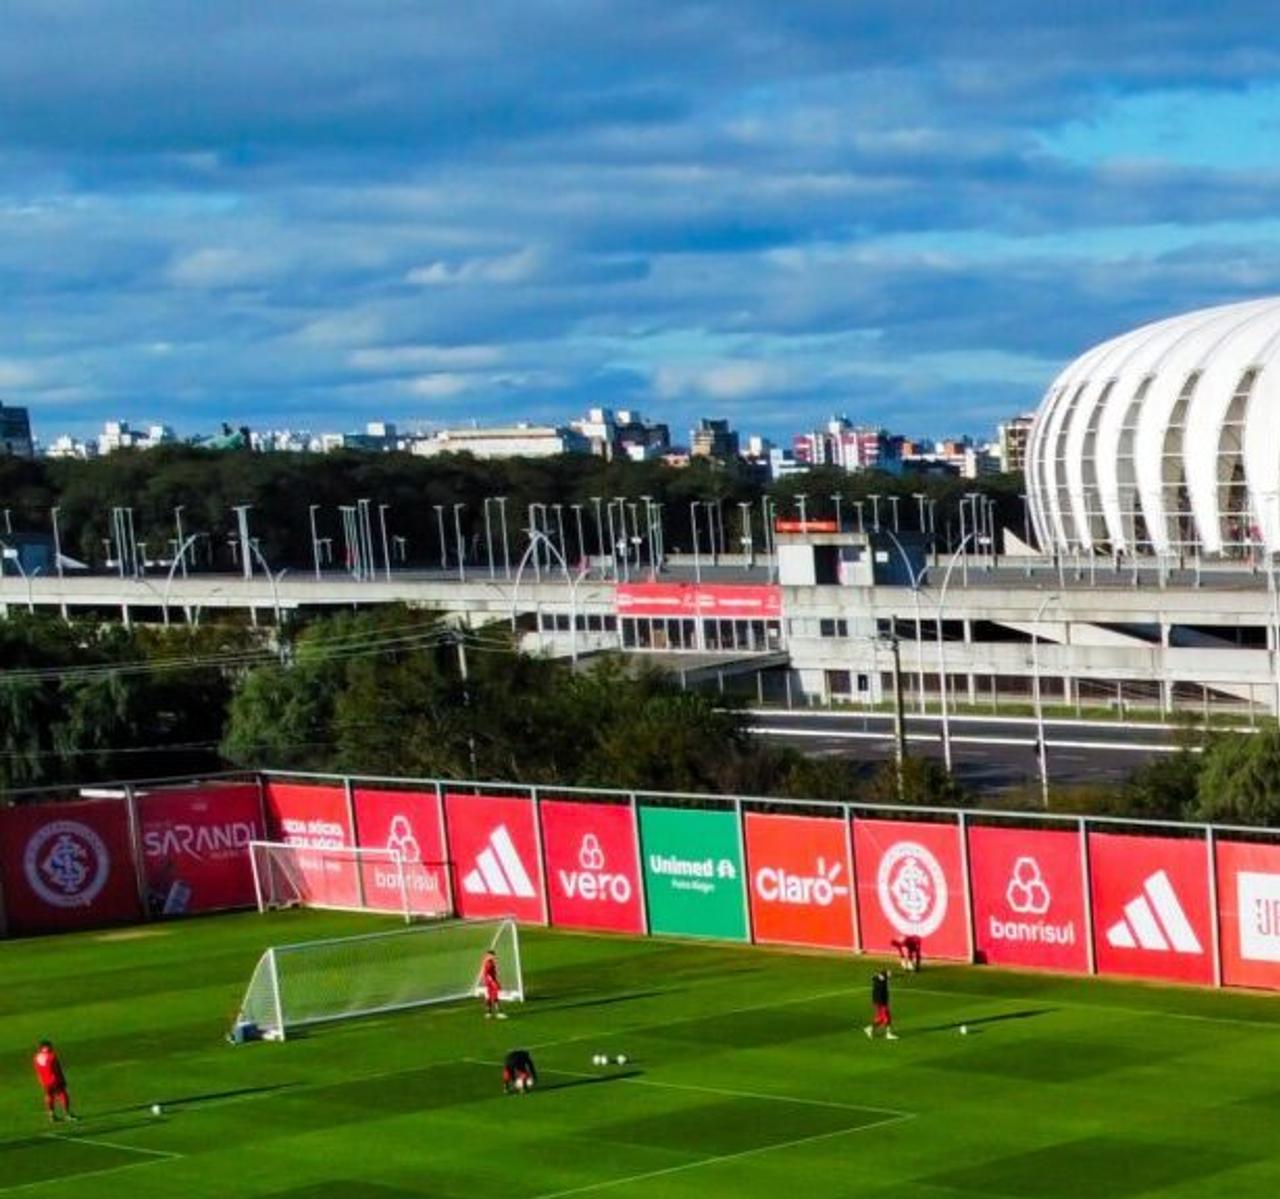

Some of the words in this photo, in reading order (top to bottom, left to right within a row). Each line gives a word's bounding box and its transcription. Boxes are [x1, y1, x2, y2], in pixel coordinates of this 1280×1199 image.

[144, 822, 257, 861] SARANDI
[650, 854, 714, 879] Unimed
[558, 869, 632, 904] vero
[756, 867, 834, 907] Claro
[989, 914, 1076, 946] banrisul
